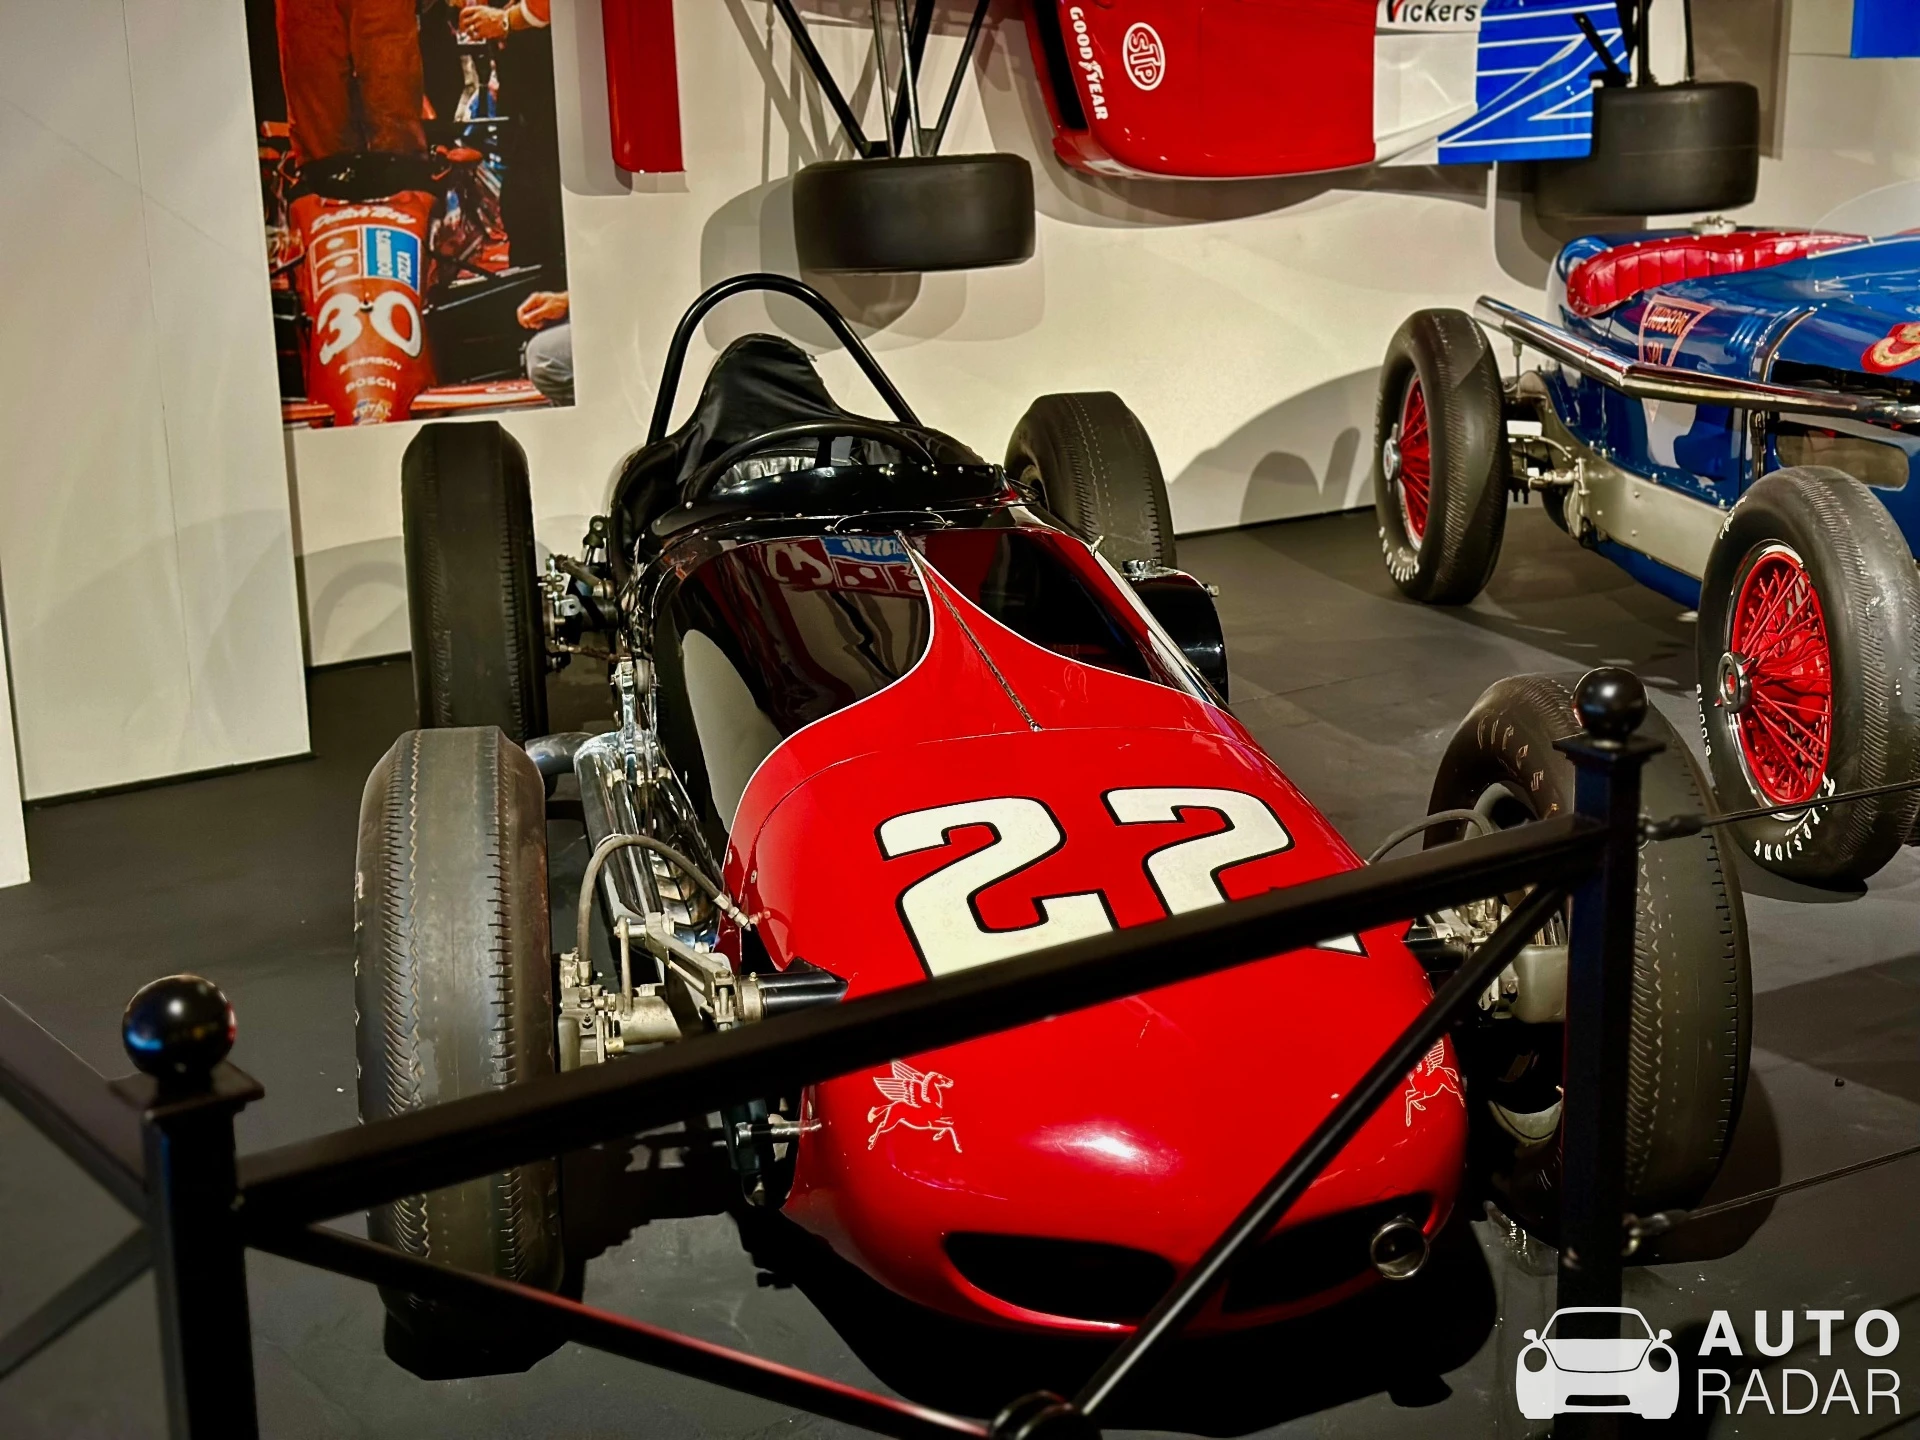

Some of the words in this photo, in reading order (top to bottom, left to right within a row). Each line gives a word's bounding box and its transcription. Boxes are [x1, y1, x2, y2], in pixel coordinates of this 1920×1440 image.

[1386, 0, 1478, 23] Vickers
[1069, 6, 1109, 120] GOODYEAR
[1128, 31, 1161, 83] STP
[316, 290, 422, 366] 30
[1644, 304, 1691, 337] HUDSON
[873, 786, 1369, 979] 22
